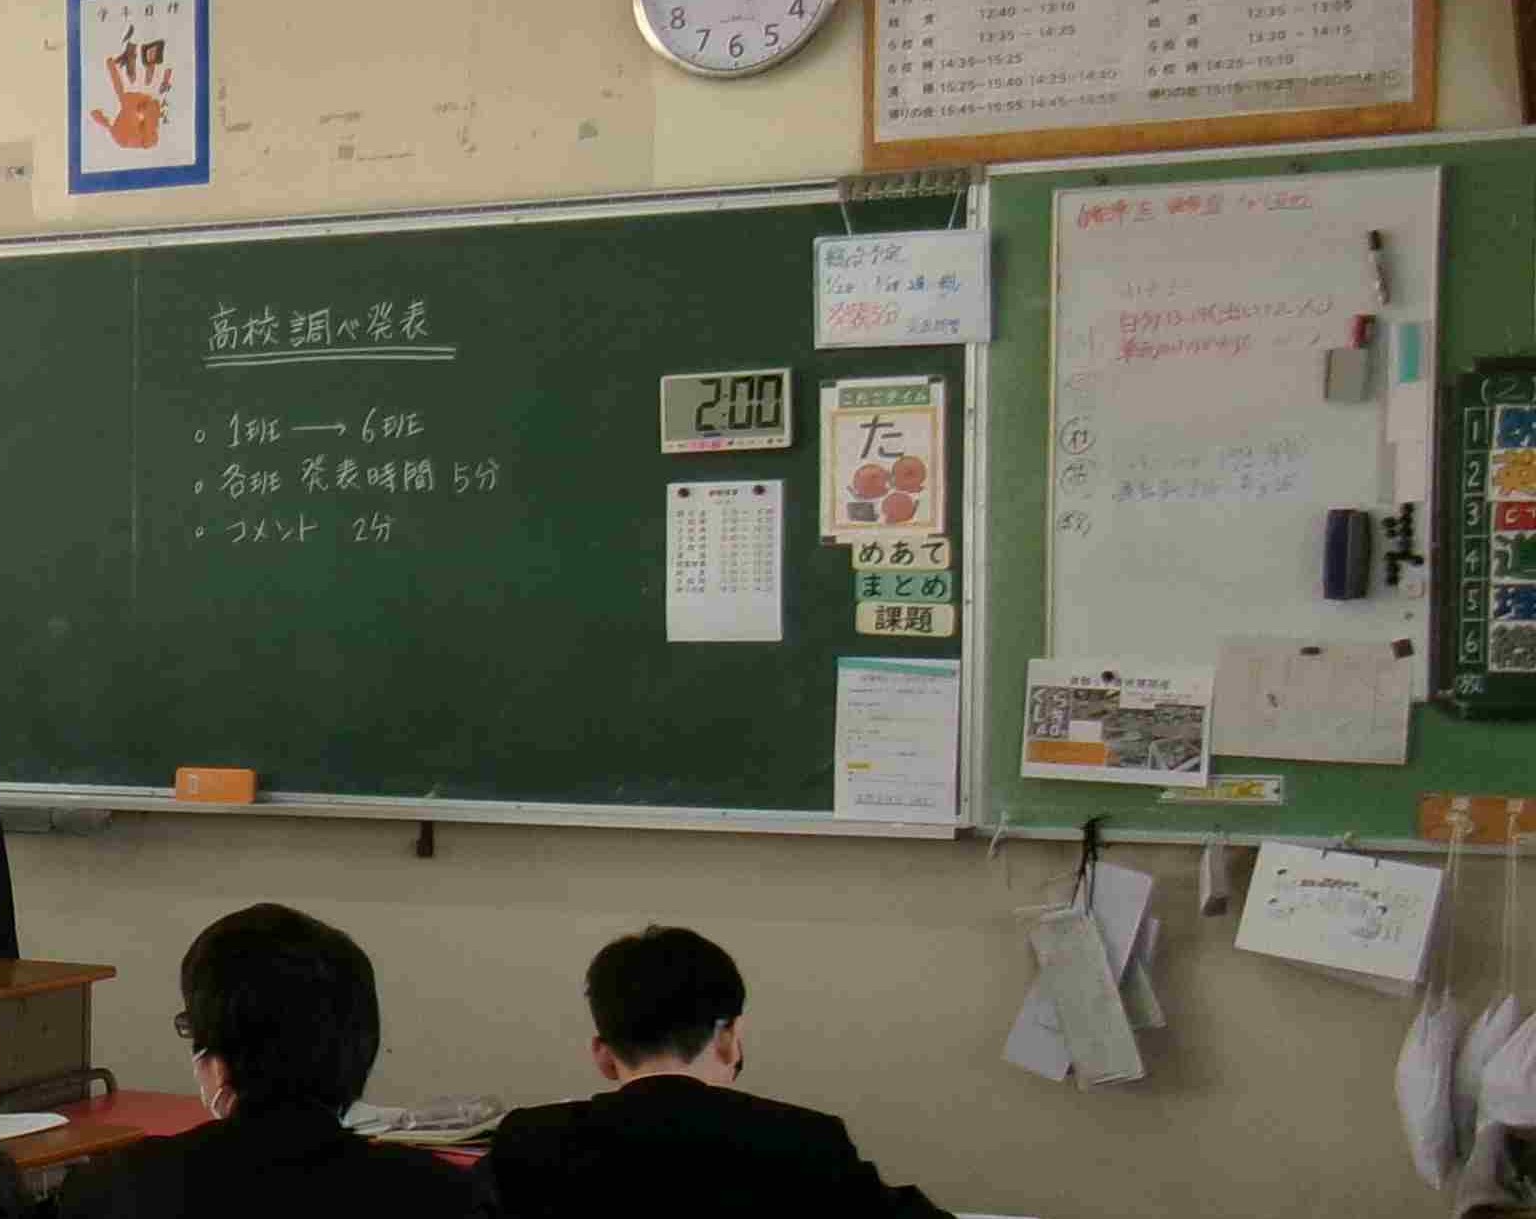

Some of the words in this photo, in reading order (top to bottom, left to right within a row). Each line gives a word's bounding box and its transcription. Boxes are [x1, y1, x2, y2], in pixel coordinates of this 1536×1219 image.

[670, 7, 685, 30] 8
[788, 0, 805, 19] 4
[696, 29, 711, 52] 7
[729, 34, 744, 58] 6
[764, 23, 778, 47] 5
[207, 298, 431, 350] 高校調べ発表
[695, 375, 783, 431] 2:00
[227, 413, 281, 447] 1班
[361, 406, 425, 444] 6班
[860, 415, 904, 459] た
[220, 462, 281, 499] 各班
[301, 454, 435, 494] 発表時間
[453, 456, 502, 492] 5分
[1468, 461, 1481, 487] 2
[1466, 502, 1479, 526] 3
[226, 513, 319, 543] コメント
[353, 512, 396, 542] 2分
[858, 541, 945, 565] めあて
[1465, 549, 1479, 572] 4
[862, 575, 945, 598] まとめ
[875, 605, 933, 633] 課題
[1465, 630, 1478, 653] 6
